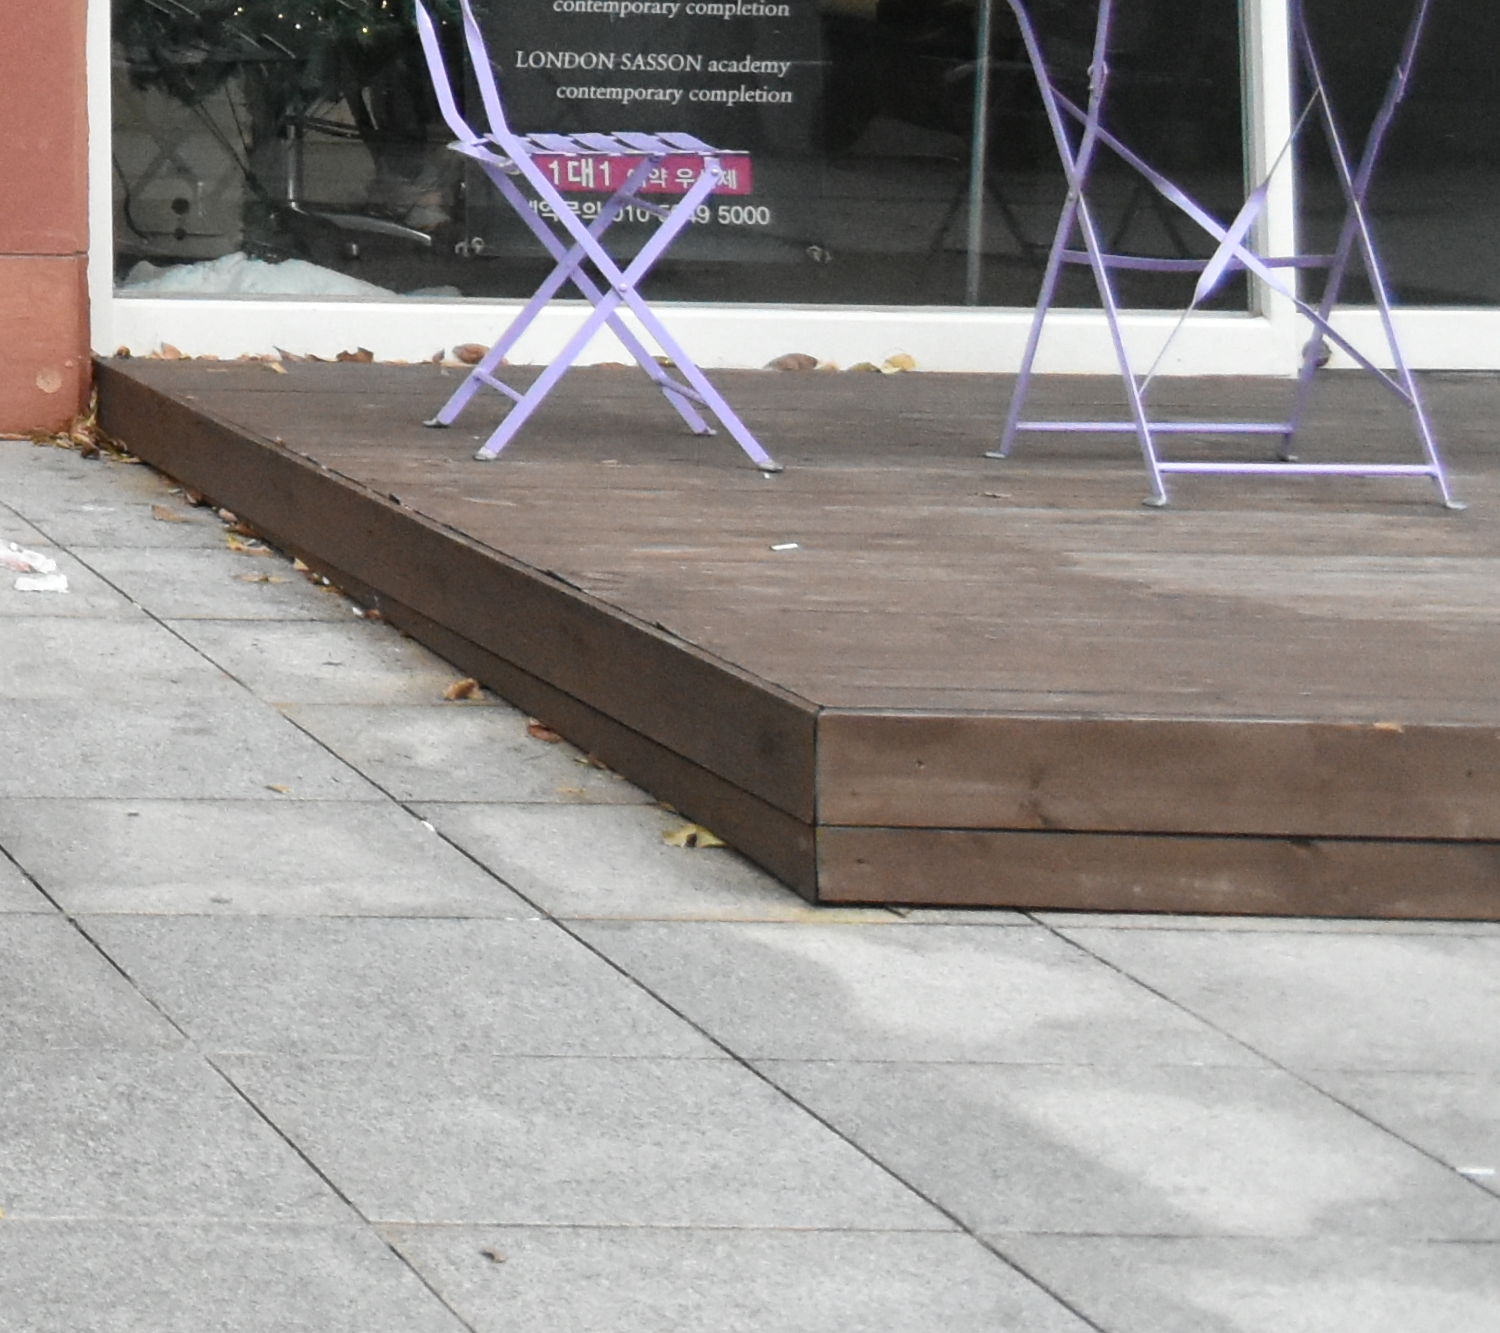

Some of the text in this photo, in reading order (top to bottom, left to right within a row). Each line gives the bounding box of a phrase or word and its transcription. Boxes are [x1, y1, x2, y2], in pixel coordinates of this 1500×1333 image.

[516, 50, 791, 77] LONDON SASSON academy
[556, 85, 793, 106] contemporary completion
[549, 157, 611, 188] 1대1
[675, 168, 738, 190] 우제
[718, 205, 770, 225] 5000
